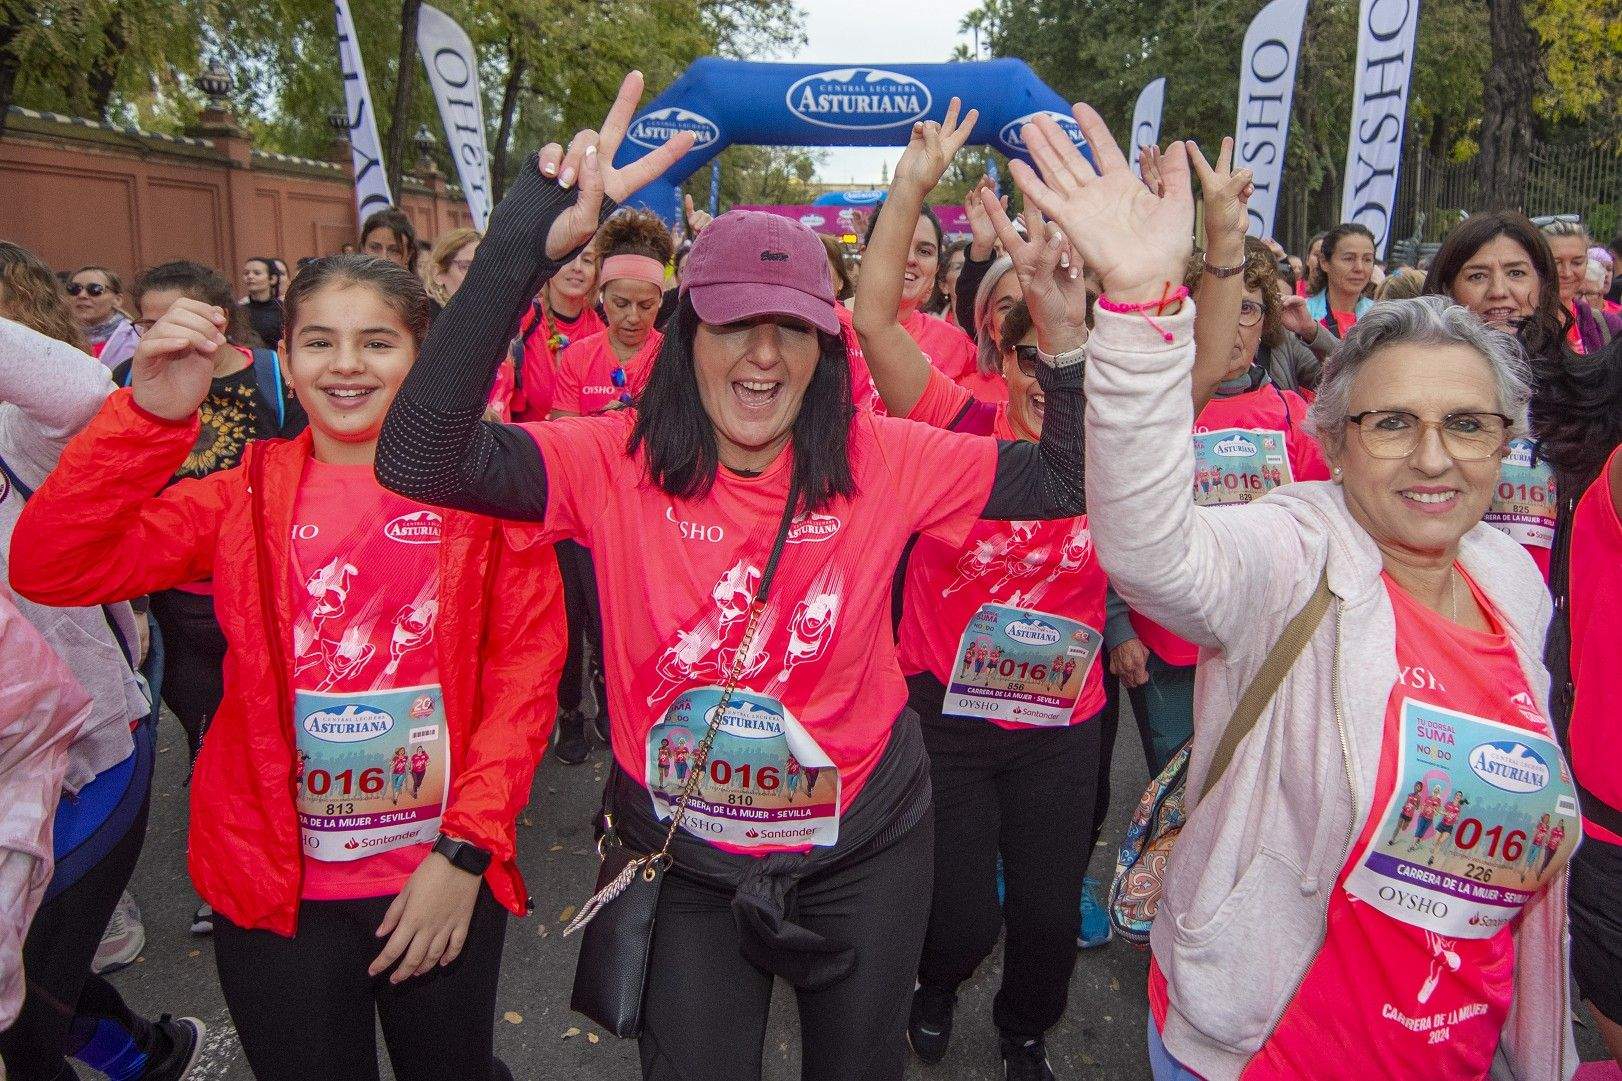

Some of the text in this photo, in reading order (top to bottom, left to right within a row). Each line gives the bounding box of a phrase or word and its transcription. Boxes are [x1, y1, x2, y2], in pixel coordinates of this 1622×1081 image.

[819, 84, 916, 93] CENTRAL LECHERA
[798, 85, 921, 113] ASTURIANA
[1224, 473, 1262, 489] 016
[1498, 482, 1545, 502] 016
[1521, 515, 1541, 523] MUJER
[389, 523, 441, 537] ASTURIA
[1008, 625, 1057, 642] ASTURIANA
[999, 659, 1047, 680] 016
[1007, 682, 1025, 691] 856
[966, 687, 994, 697] CARRERA
[1012, 692, 1032, 701] MUJER
[1036, 695, 1060, 706] SEVILLA
[959, 698, 1061, 720] OYSHO Santander
[309, 717, 388, 734] ASTURIANA
[1416, 725, 1455, 745] SUMA
[710, 759, 780, 790] 016
[1474, 751, 1544, 787] ASTURIANA
[307, 767, 385, 795] 016
[325, 803, 354, 815] 813
[728, 794, 753, 806] 810
[310, 818, 322, 827] DE
[324, 818, 336, 828] LA
[339, 818, 372, 827] MUJER
[380, 811, 417, 824] SEVILLA
[713, 804, 724, 814] DE
[726, 807, 738, 816] LA
[739, 808, 769, 819] MUJER
[777, 808, 812, 818] SEVILLA
[683, 815, 817, 839] YSHO Santander
[361, 829, 421, 848] Santander
[1454, 818, 1527, 862] 016
[1397, 864, 1440, 886] CARRERA
[1442, 878, 1457, 890] DE
[1458, 881, 1470, 894] LA
[1472, 885, 1499, 900] MUJER
[1464, 863, 1493, 882] 226
[1378, 885, 1448, 918] OYSHO
[1382, 1002, 1489, 1032] CARRERA DE LA MUJER
[1427, 1027, 1450, 1045] 2024
